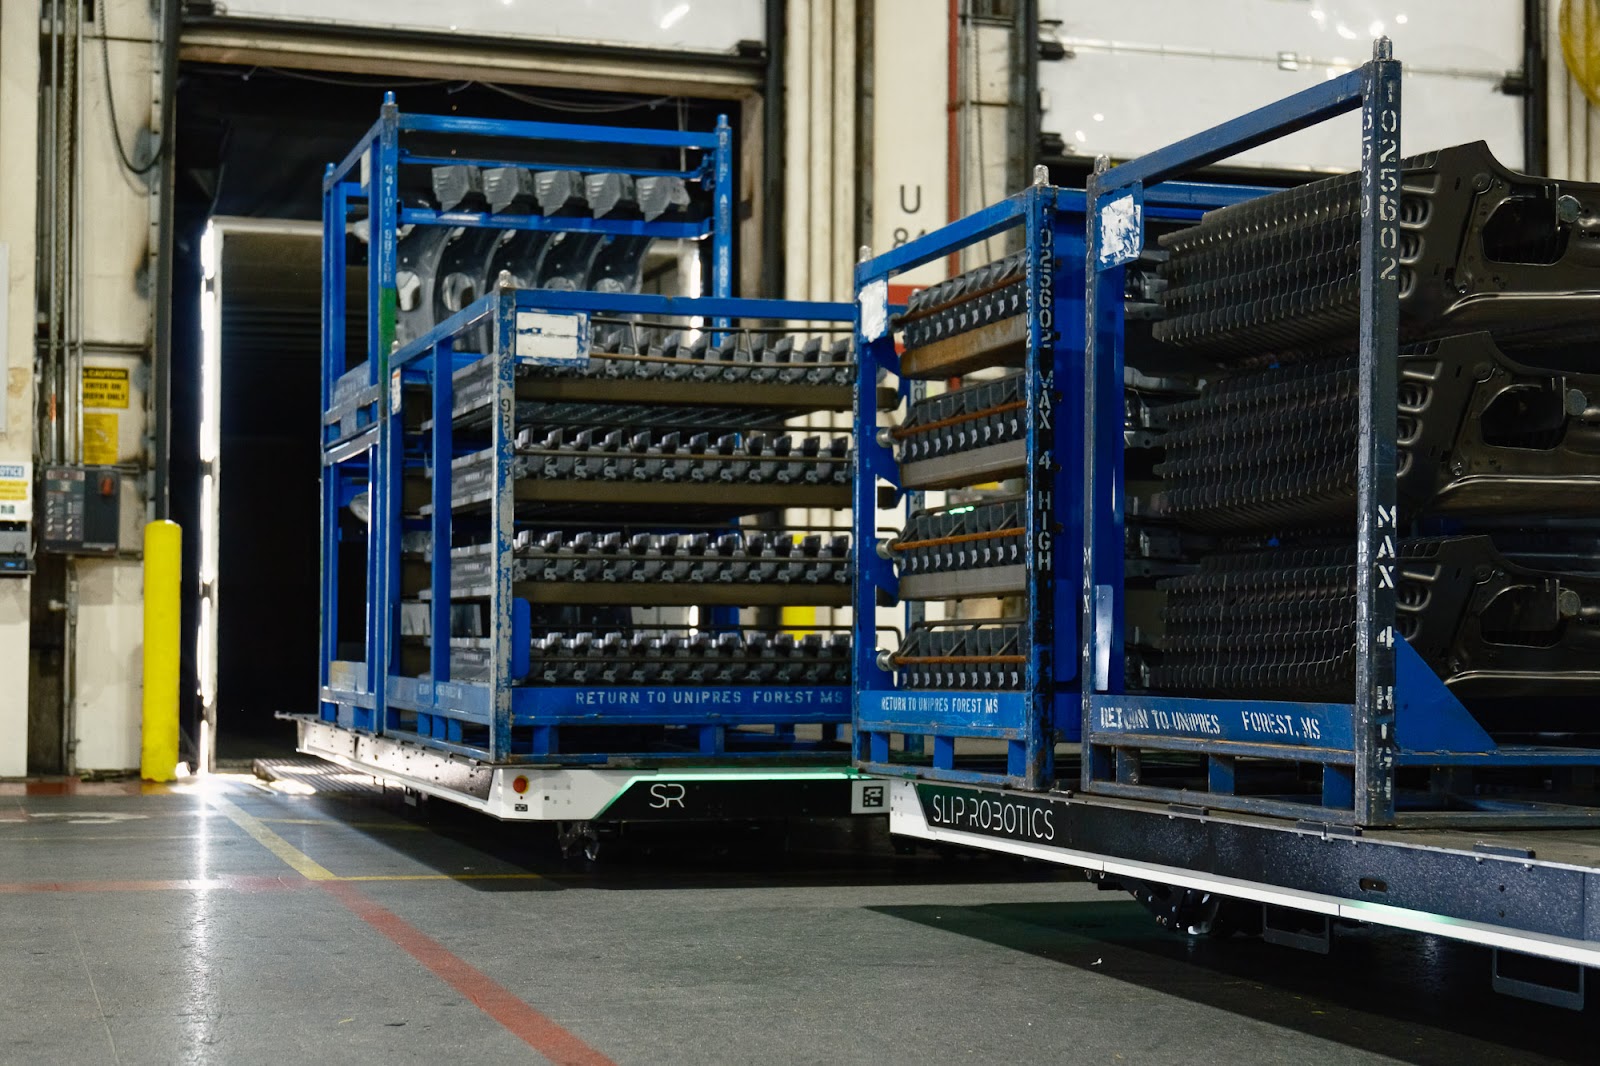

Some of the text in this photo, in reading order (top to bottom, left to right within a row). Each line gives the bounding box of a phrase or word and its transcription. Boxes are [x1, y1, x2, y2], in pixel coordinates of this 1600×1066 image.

[1379, 82, 1397, 281] 1025602
[899, 184, 922, 214] U
[85, 382, 108, 390] ENTER
[88, 369, 125, 378] CAUTION
[107, 393, 125, 401] ONLY
[1038, 370, 1053, 430] MAX
[0, 466, 23, 476] OTICE
[1038, 450, 1052, 470] 4
[1038, 490, 1052, 571] HIGH
[1374, 504, 1397, 589] MAX
[1083, 546, 1092, 614] MAX
[1377, 624, 1394, 649] 4
[575, 691, 844, 705] RETURN TO UNIPRES FOREST MS
[881, 696, 999, 713] RETURN TO UNIPRES FOREST MS
[1151, 709, 1170, 729] TO
[1172, 711, 1221, 734] UNIPRES
[1300, 716, 1322, 740] MS
[648, 783, 686, 809] SR
[932, 794, 1055, 841] SLIP ROBOTICS
